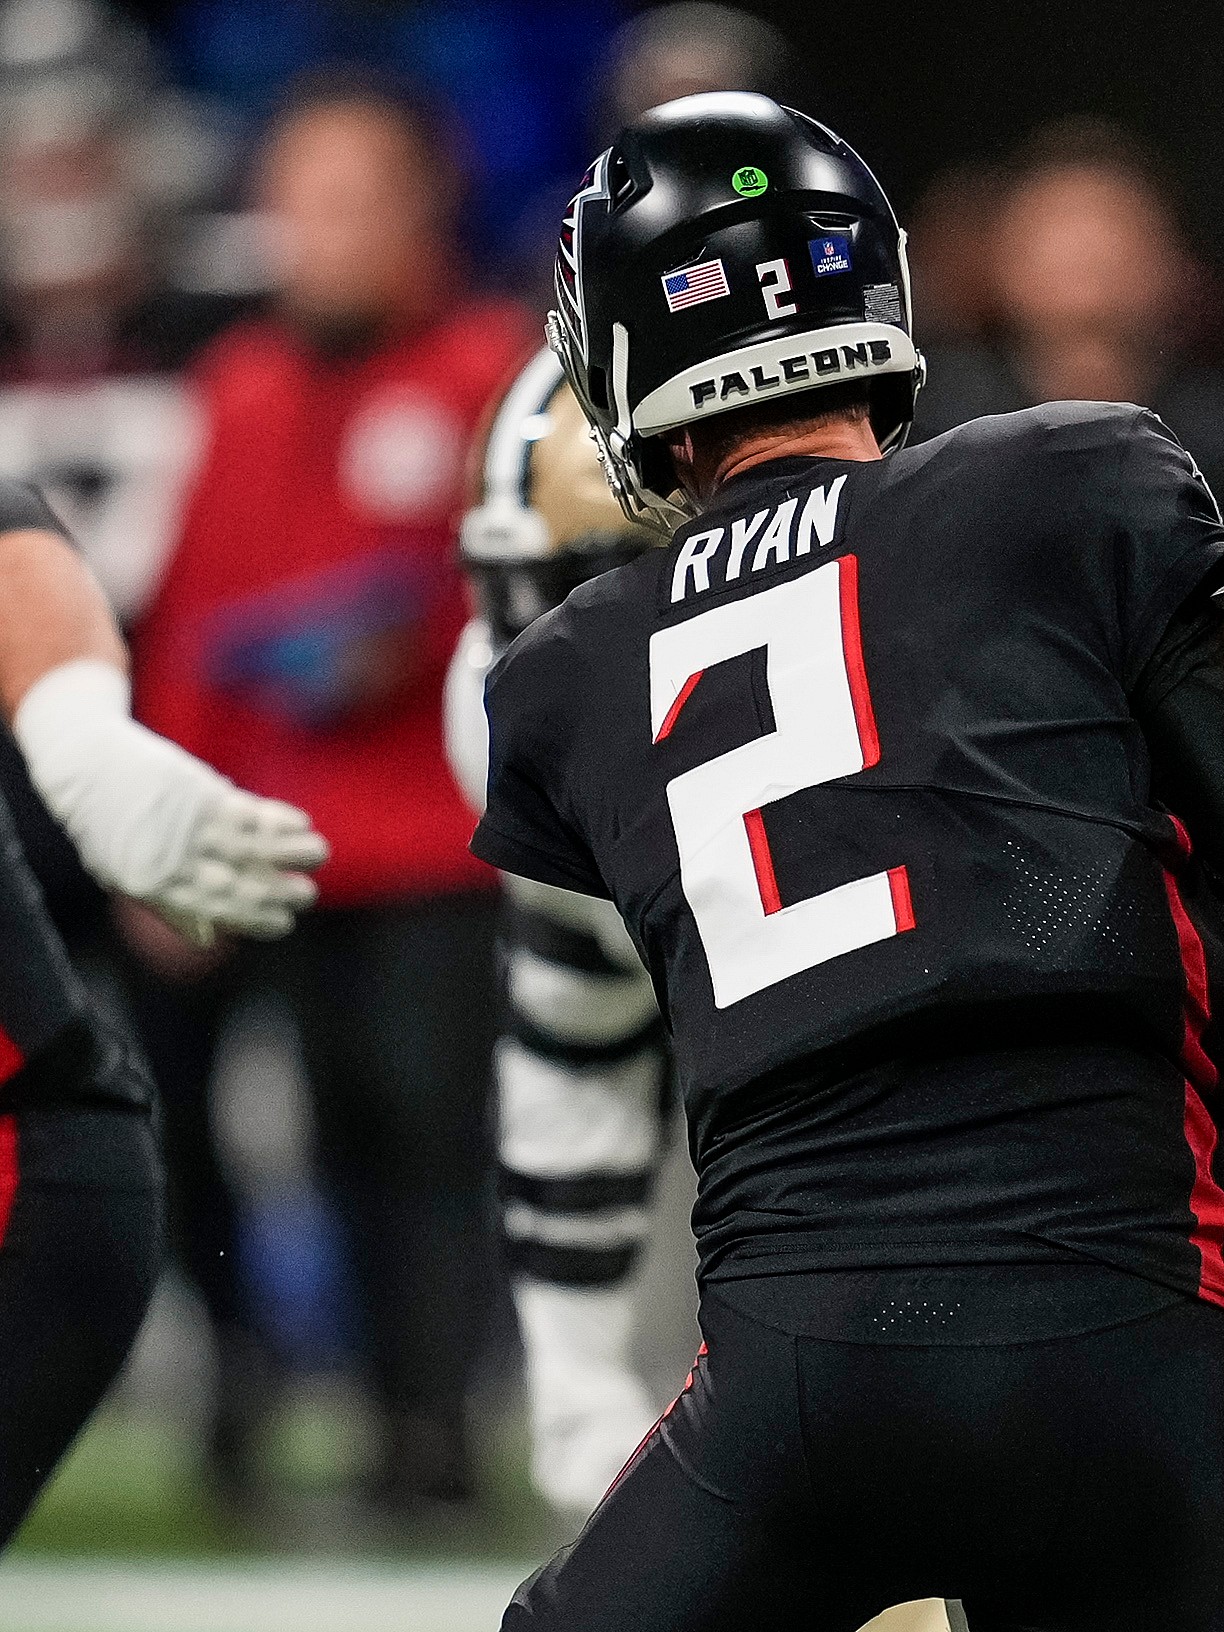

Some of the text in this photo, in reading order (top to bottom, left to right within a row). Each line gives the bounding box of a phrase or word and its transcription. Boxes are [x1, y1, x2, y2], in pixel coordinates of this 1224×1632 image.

[755, 258, 799, 320] 2
[817, 259, 849, 274] CHANGE
[689, 339, 892, 410] FALCONS
[670, 474, 848, 604] RYAN
[648, 552, 916, 1010] 2
